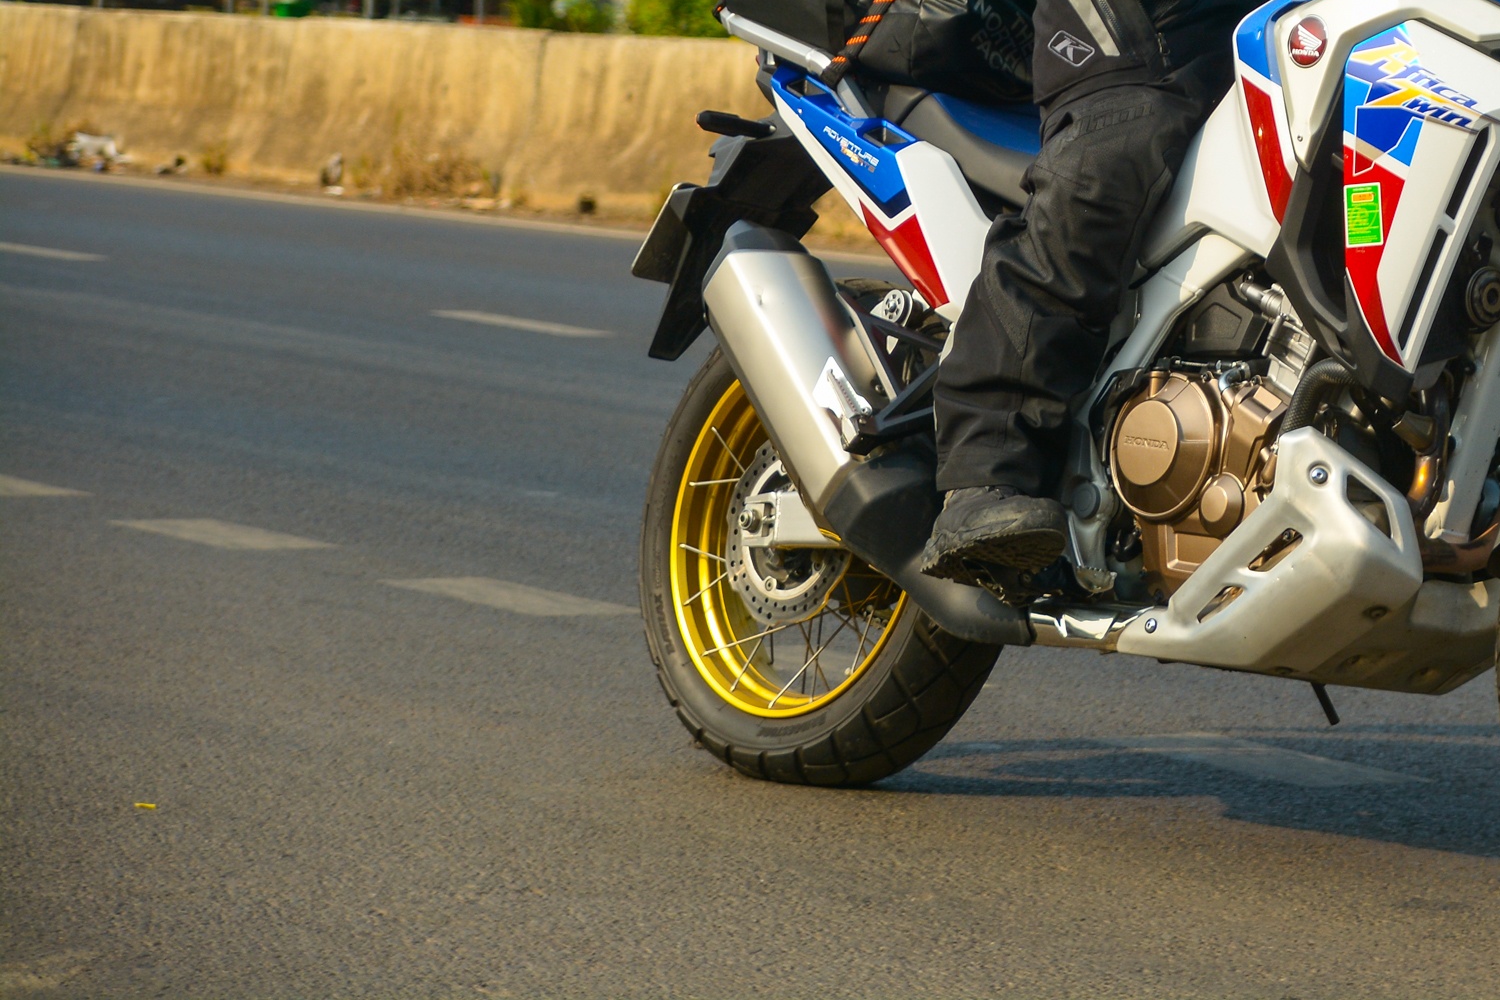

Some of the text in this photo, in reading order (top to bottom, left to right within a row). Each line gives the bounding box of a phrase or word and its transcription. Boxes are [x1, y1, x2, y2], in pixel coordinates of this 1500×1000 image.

[1292, 47, 1320, 58] HONDA
[1350, 36, 1478, 110] Africa
[823, 125, 880, 167] ADVENTURE
[1124, 435, 1169, 450] HONDA
